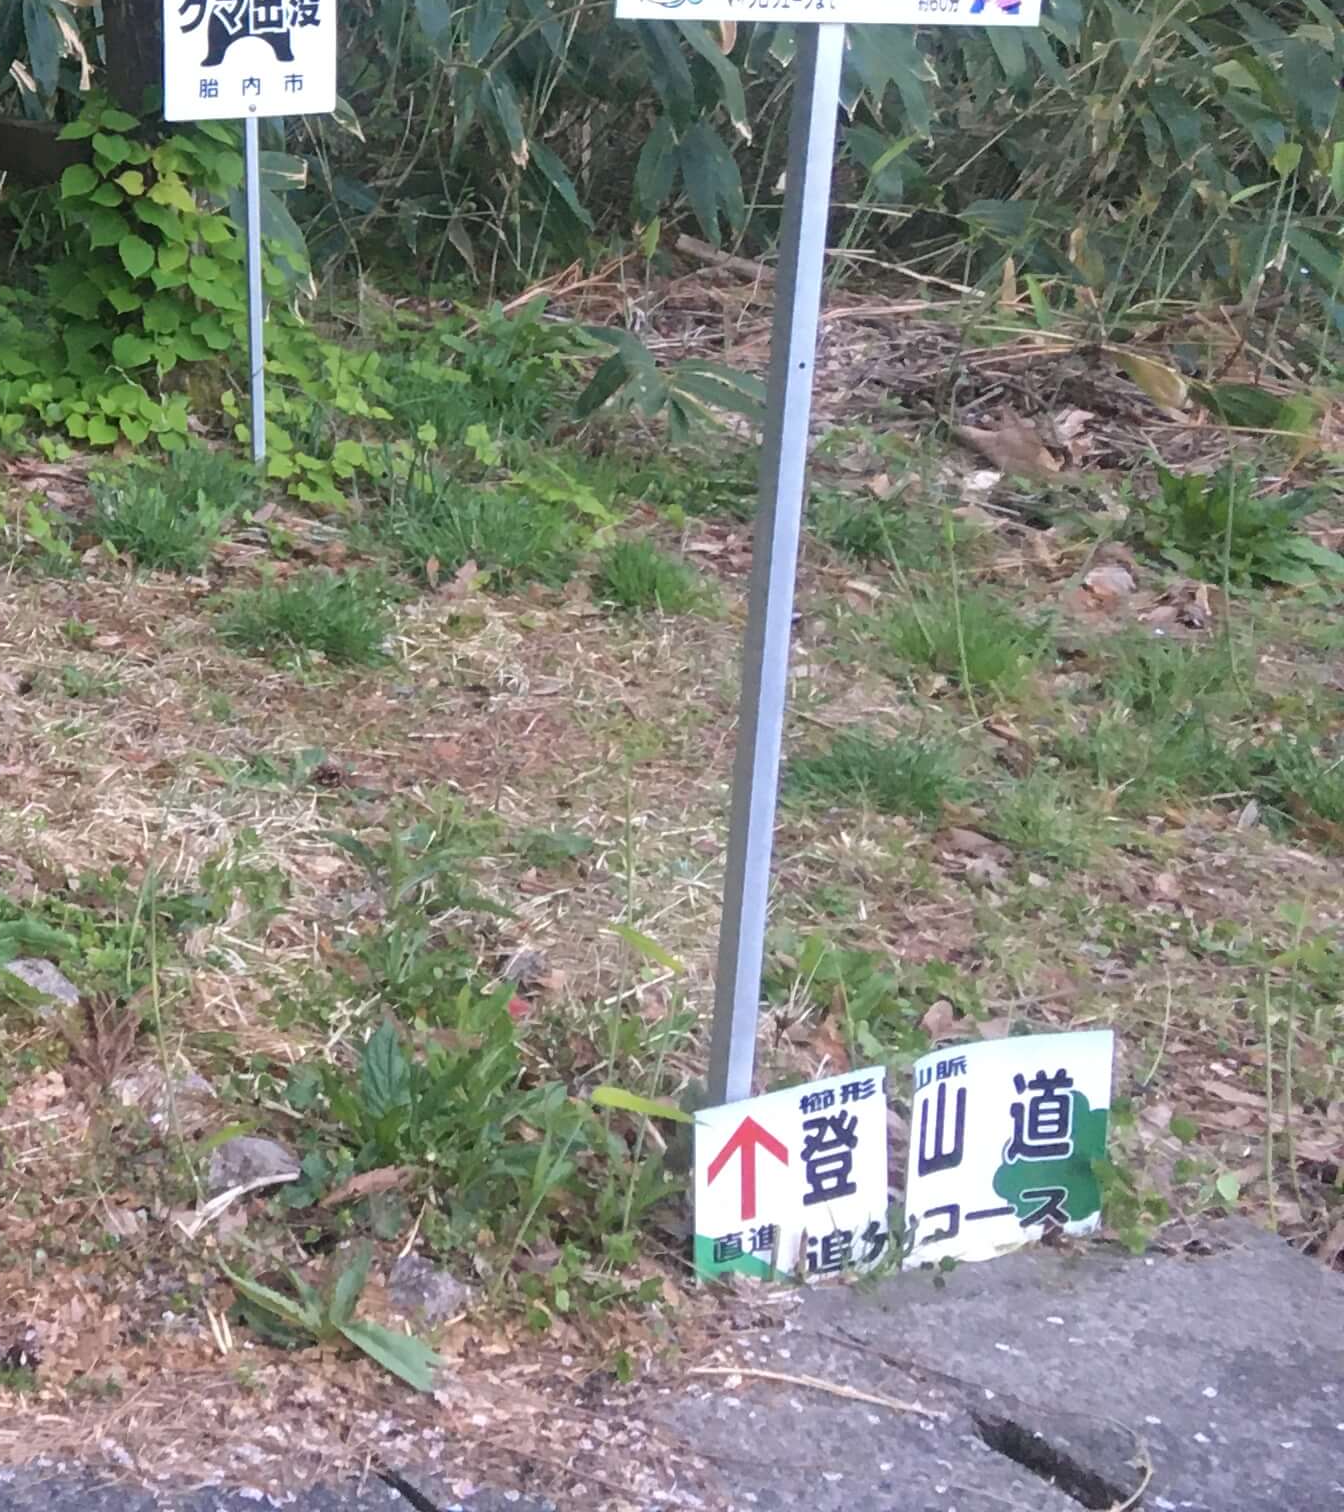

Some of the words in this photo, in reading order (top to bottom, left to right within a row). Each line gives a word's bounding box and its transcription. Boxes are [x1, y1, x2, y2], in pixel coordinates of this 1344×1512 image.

[199, 74, 304, 99] 胎内市
[801, 1068, 1075, 1207] 登山道
[714, 1221, 780, 1264] 直進
